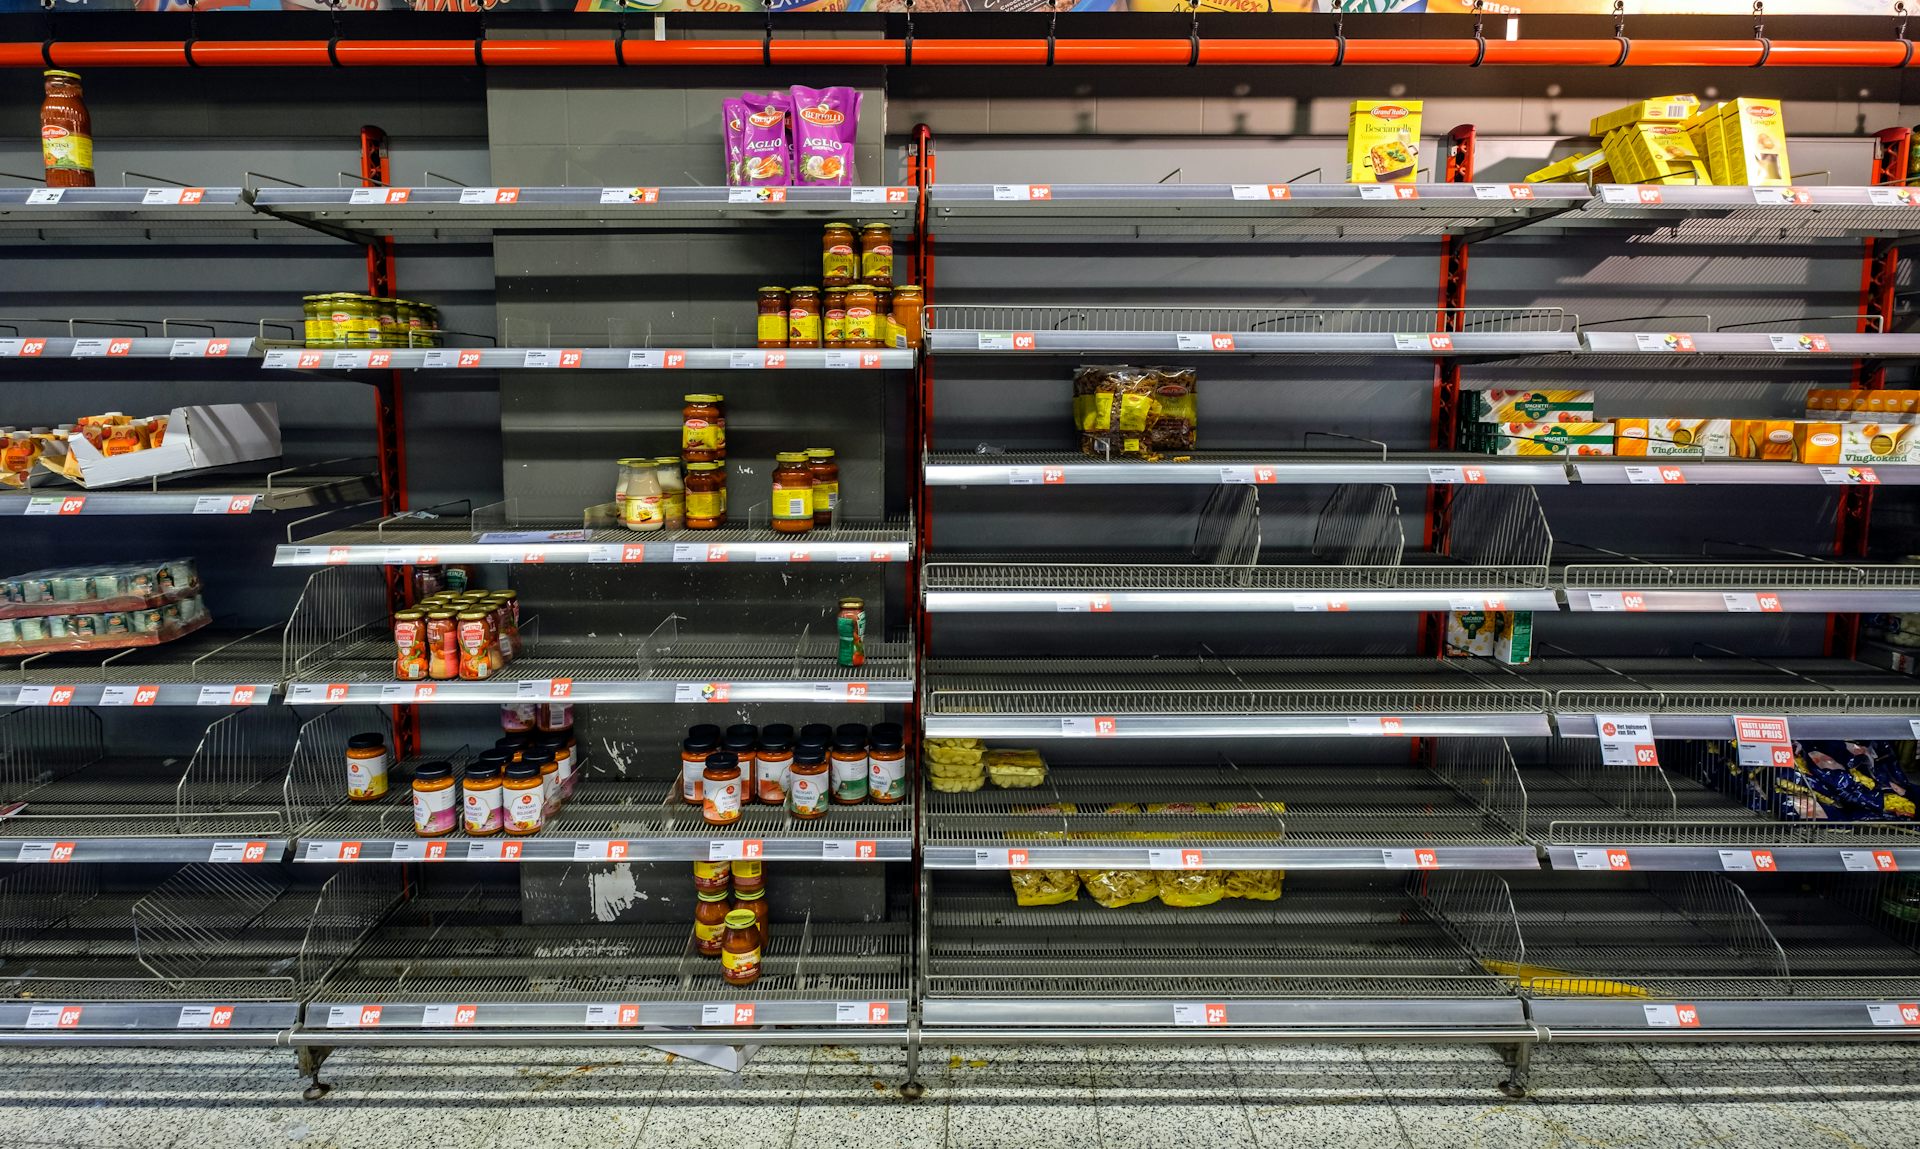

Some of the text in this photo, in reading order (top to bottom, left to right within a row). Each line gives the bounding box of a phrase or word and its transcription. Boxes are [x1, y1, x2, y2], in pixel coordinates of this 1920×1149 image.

[805, 110, 841, 121] BERTOLLI
[747, 137, 782, 150] AGLIO
[803, 137, 842, 149] AGLIO
[1845, 454, 1907, 464] Vlugkokend
[52, 690, 71, 702] 0.95
[136, 690, 156, 702] 0.99
[1743, 729, 1784, 739] DIRK PRIJS
